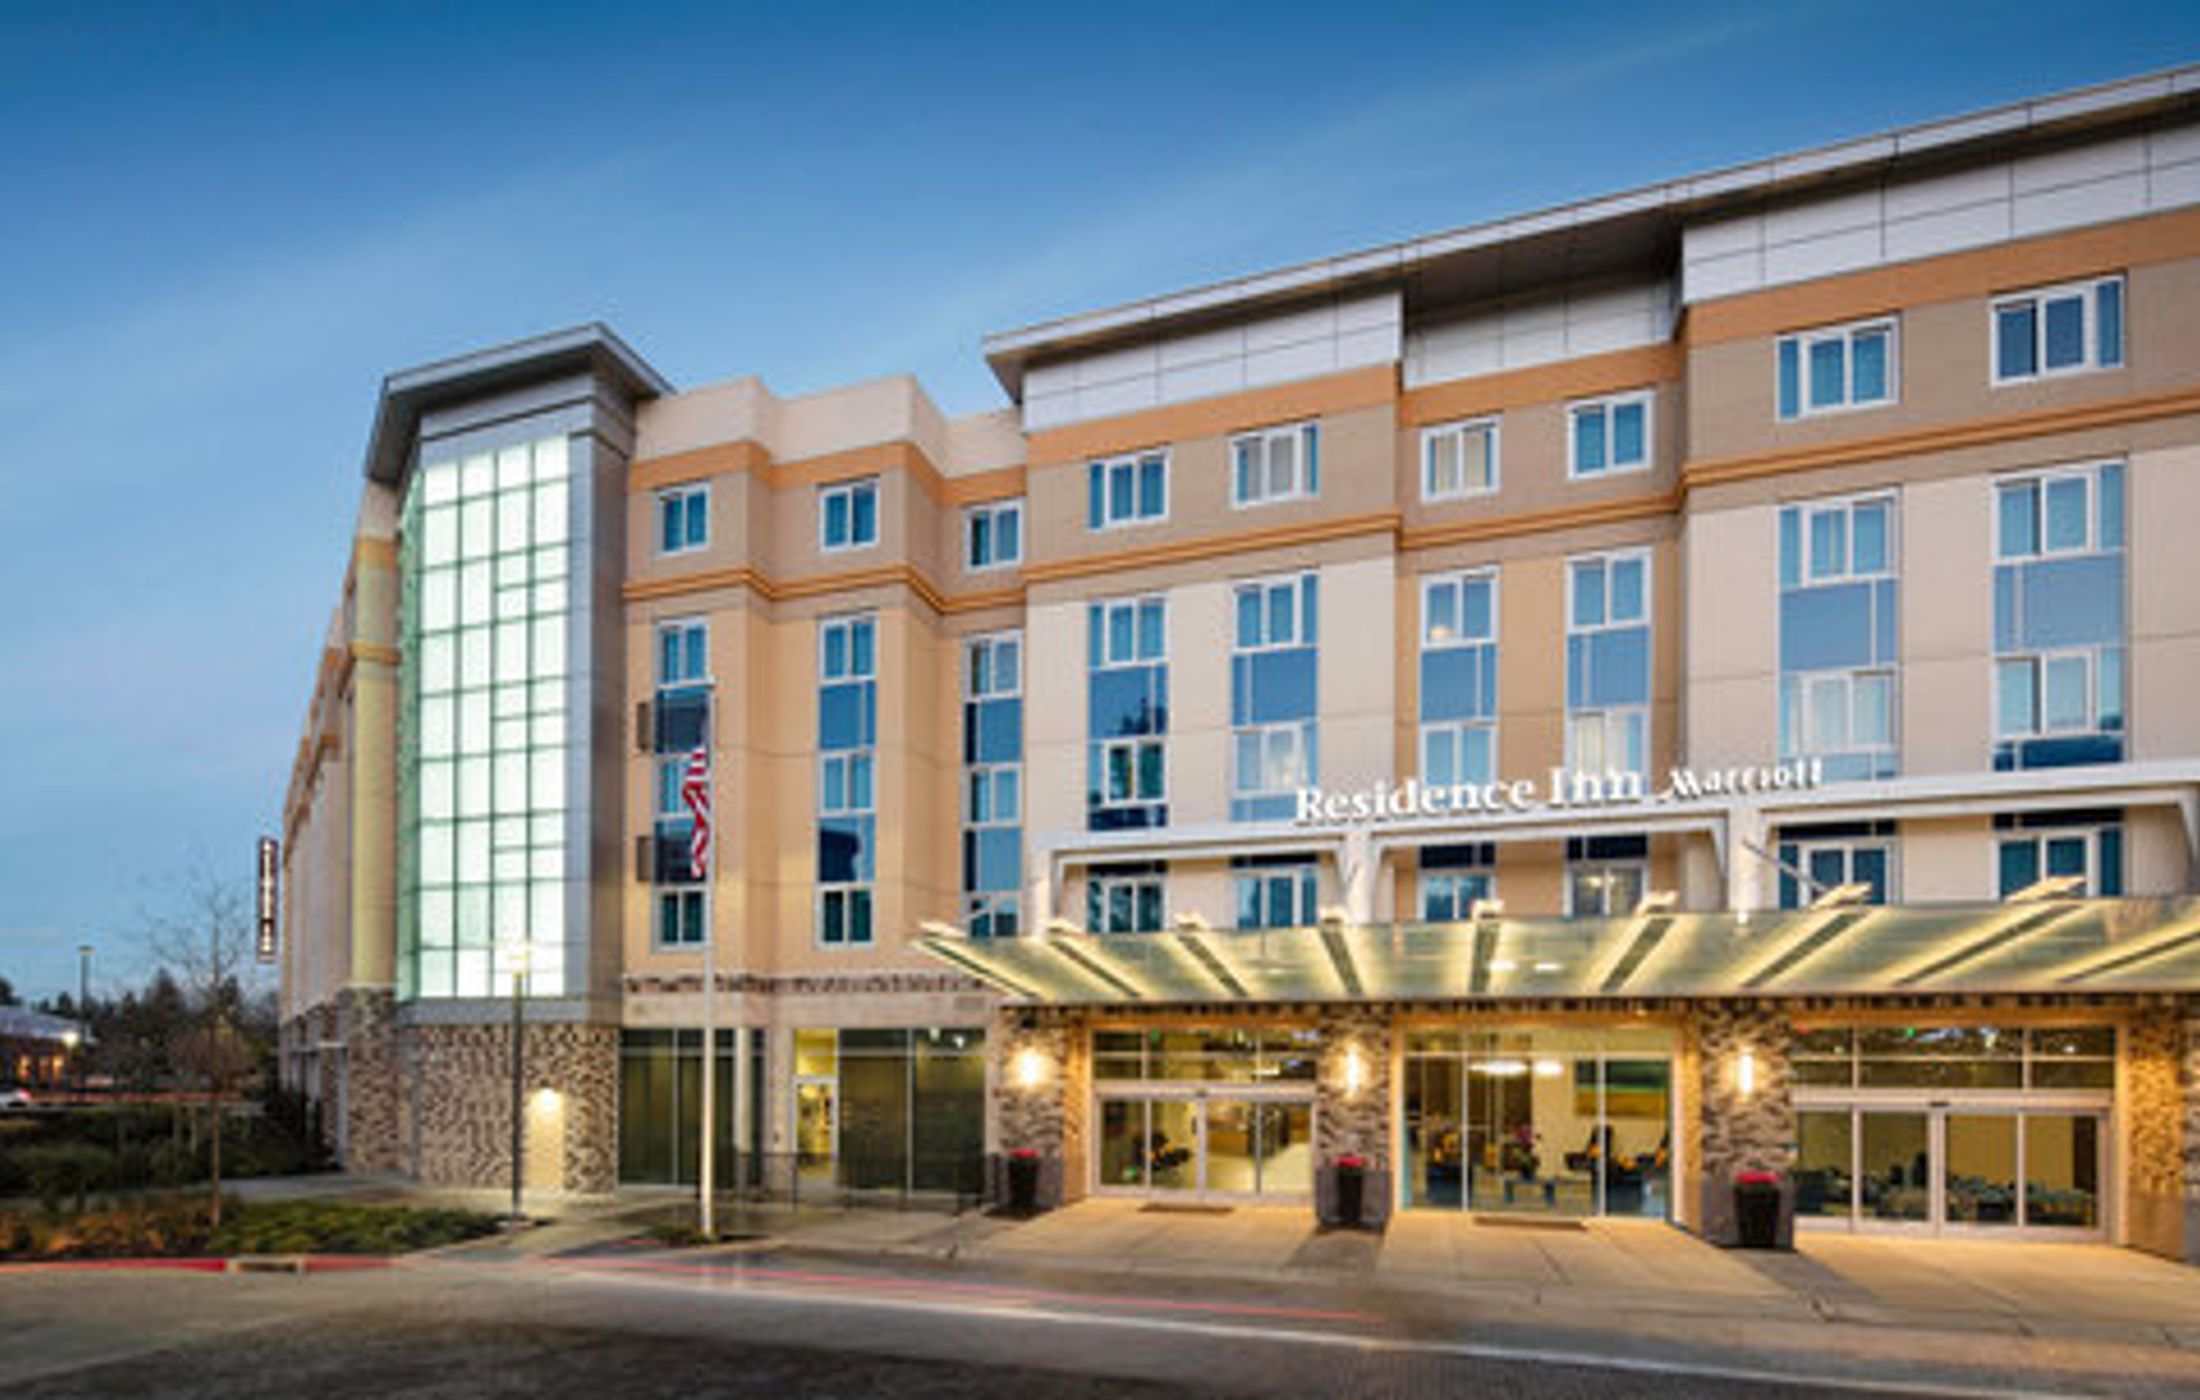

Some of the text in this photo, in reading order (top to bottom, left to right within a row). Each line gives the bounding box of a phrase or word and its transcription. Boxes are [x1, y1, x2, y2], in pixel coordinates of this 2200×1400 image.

[1294, 757, 1823, 823] Residence Inn Marriott
